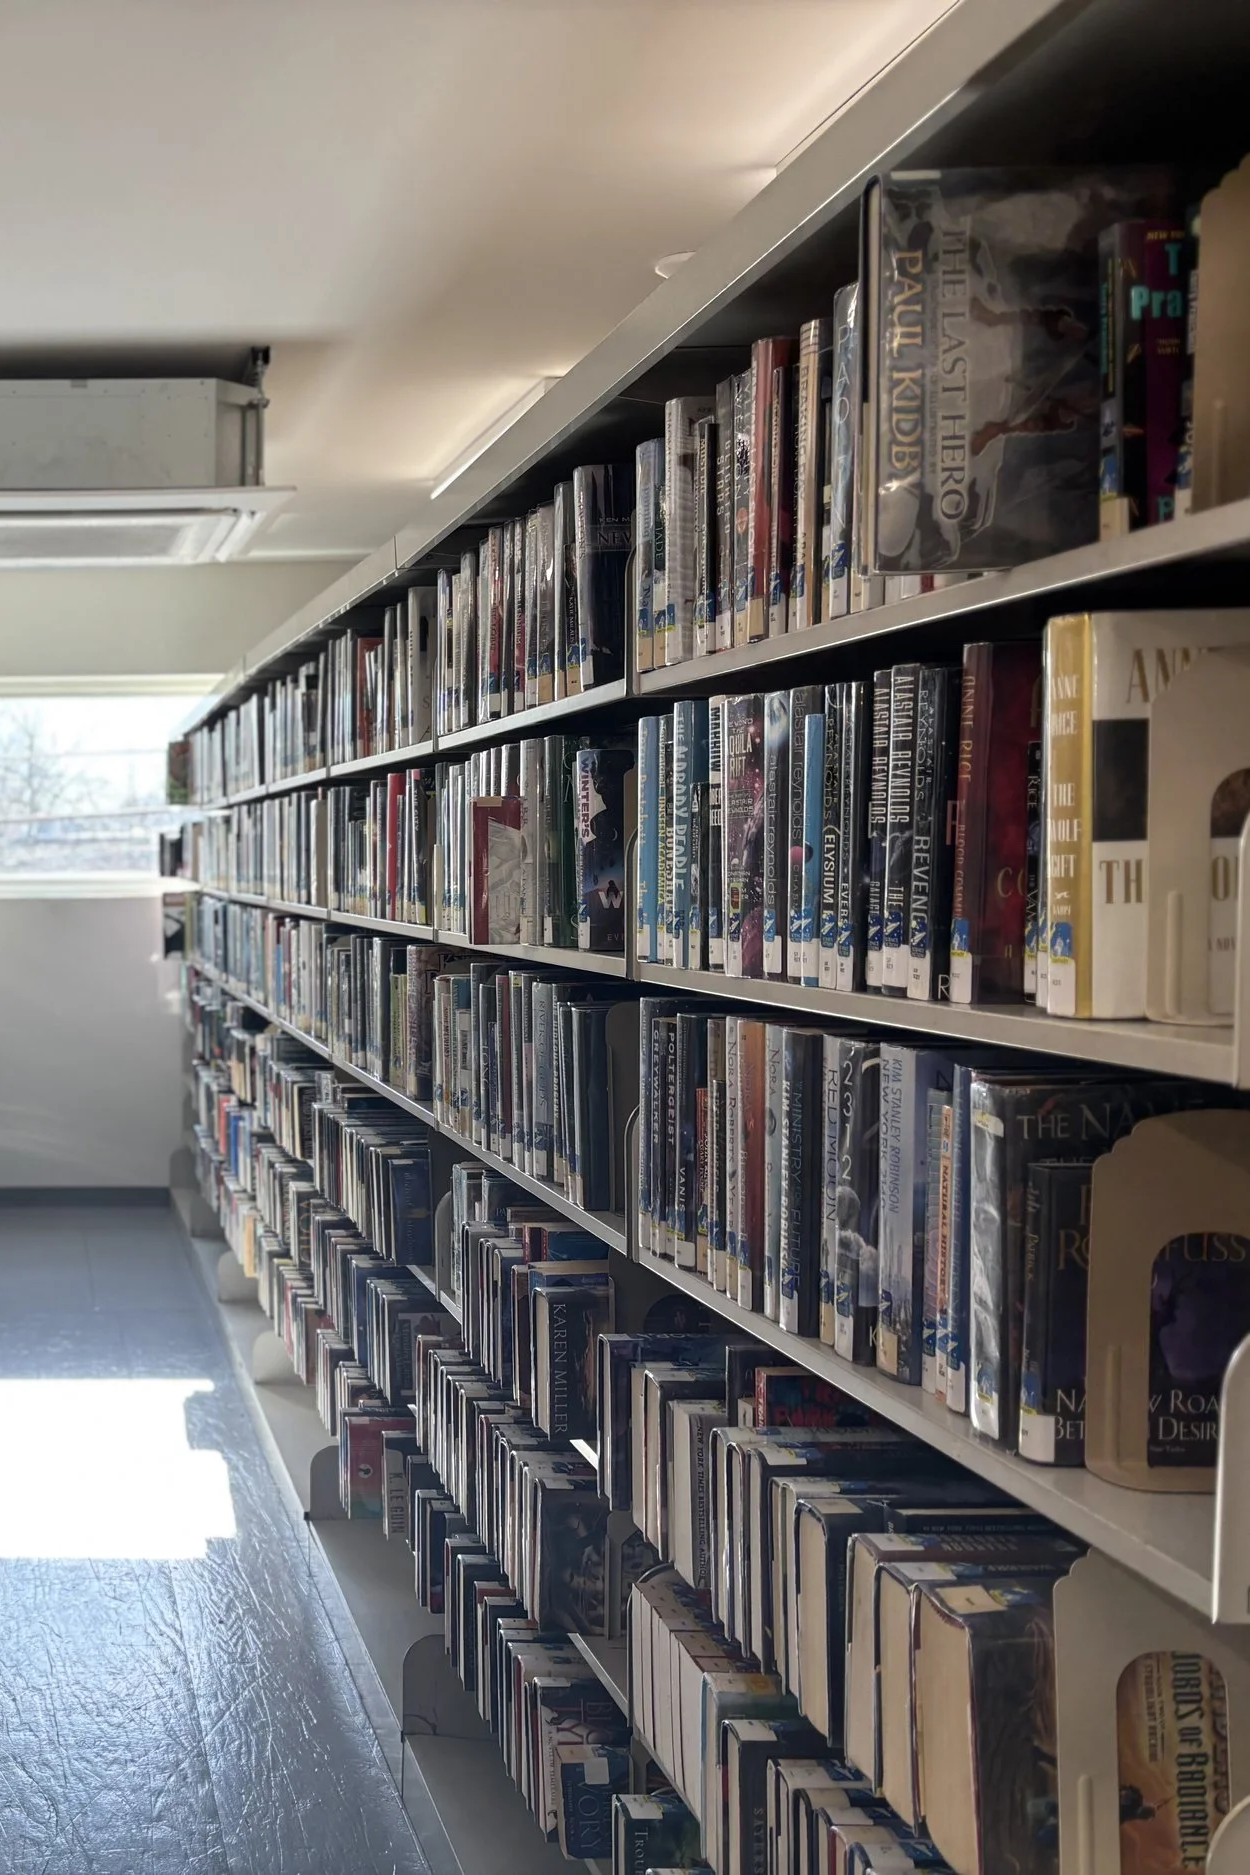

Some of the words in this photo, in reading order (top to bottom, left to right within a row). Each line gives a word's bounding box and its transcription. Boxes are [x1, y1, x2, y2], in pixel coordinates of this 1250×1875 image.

[941, 229, 968, 298] THE
[892, 250, 925, 358] PAUL
[1130, 285, 1183, 321] Pra
[941, 311, 968, 392] LAST
[889, 367, 925, 501] KIDBY
[717, 454, 725, 518] STARS
[940, 411, 968, 521] HERO
[793, 692, 807, 753] alastair
[871, 687, 890, 748] ALASTAIR
[889, 676, 915, 743] ALASTAIR
[915, 689, 930, 803] REYNOLDS
[581, 756, 591, 839] WINTER'S
[674, 745, 690, 818] NOBODY
[767, 754, 780, 818] alastair
[791, 762, 808, 840] reynolds
[869, 756, 888, 826] REYNOLDS
[888, 750, 912, 825] REYNOLDS
[658, 796, 667, 838] UNSEEN
[674, 823, 688, 890] PEOPLE
[765, 825, 780, 904] reynolds
[823, 834, 838, 898] ELYSIUM
[911, 835, 932, 924] REVENG
[841, 882, 850, 926] EVERS
[887, 886, 905, 908] THE
[1025, 890, 1039, 921] VAM
[538, 1000, 547, 1038] RIVER
[538, 1064, 548, 1107] GODS
[652, 1029, 660, 1145] GREYWALKER
[667, 1032, 676, 1146] POLTERGEIST
[727, 1041, 738, 1089] NORA
[769, 1048, 781, 1097] NORA
[781, 1080, 791, 1111] KIM
[881, 1058, 890, 1104] NEW
[891, 1058, 904, 1083] KIM
[790, 1092, 803, 1164] MINISTRY
[827, 1069, 838, 1125] RED
[840, 1061, 854, 1181] 2312
[888, 1087, 902, 1144] STANLEY
[1016, 1115, 1070, 1139] THE
[727, 1096, 737, 1164] ROBERTS
[780, 1117, 790, 1188] STANLEY
[880, 1111, 890, 1161] YORK
[679, 1167, 687, 1213] VANIS
[728, 1184, 737, 1230] YEAR
[826, 1133, 838, 1222] MOON
[886, 1146, 901, 1214] ROBINSON
[941, 1164, 949, 1229] NATURAL
[779, 1195, 789, 1270] ROBINS
[552, 1303, 568, 1364] KAREN
[554, 1369, 569, 1434] MILLER
[1054, 1417, 1086, 1441] BET
[1159, 1416, 1221, 1442] DESIR
[1170, 1388, 1220, 1415] ROA
[696, 1425, 704, 1445] NEW
[697, 1446, 706, 1468] YORK
[389, 1488, 405, 1502] LE
[697, 1470, 706, 1494] TIMES
[698, 1495, 708, 1545] BESTSELLING
[1177, 1726, 1204, 1749] OF
